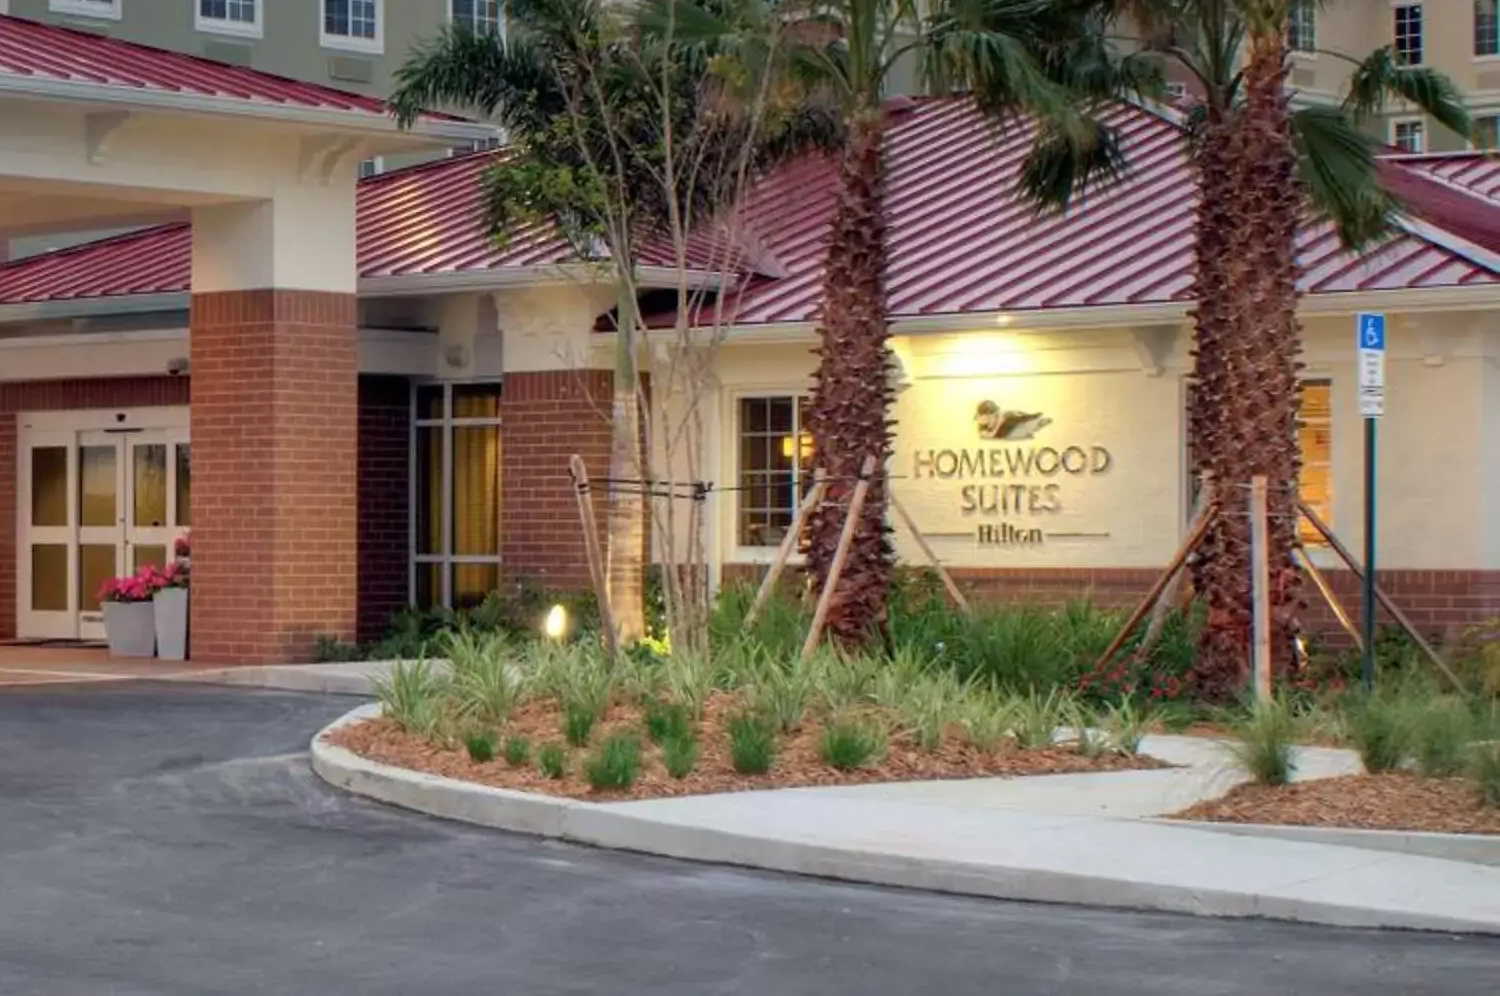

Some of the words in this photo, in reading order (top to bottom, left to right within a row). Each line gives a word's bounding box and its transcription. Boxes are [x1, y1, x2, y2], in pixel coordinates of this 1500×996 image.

[913, 445, 1112, 479] HOMEWOOD
[960, 483, 1062, 515] SUITES
[977, 522, 1043, 544] Hilton
